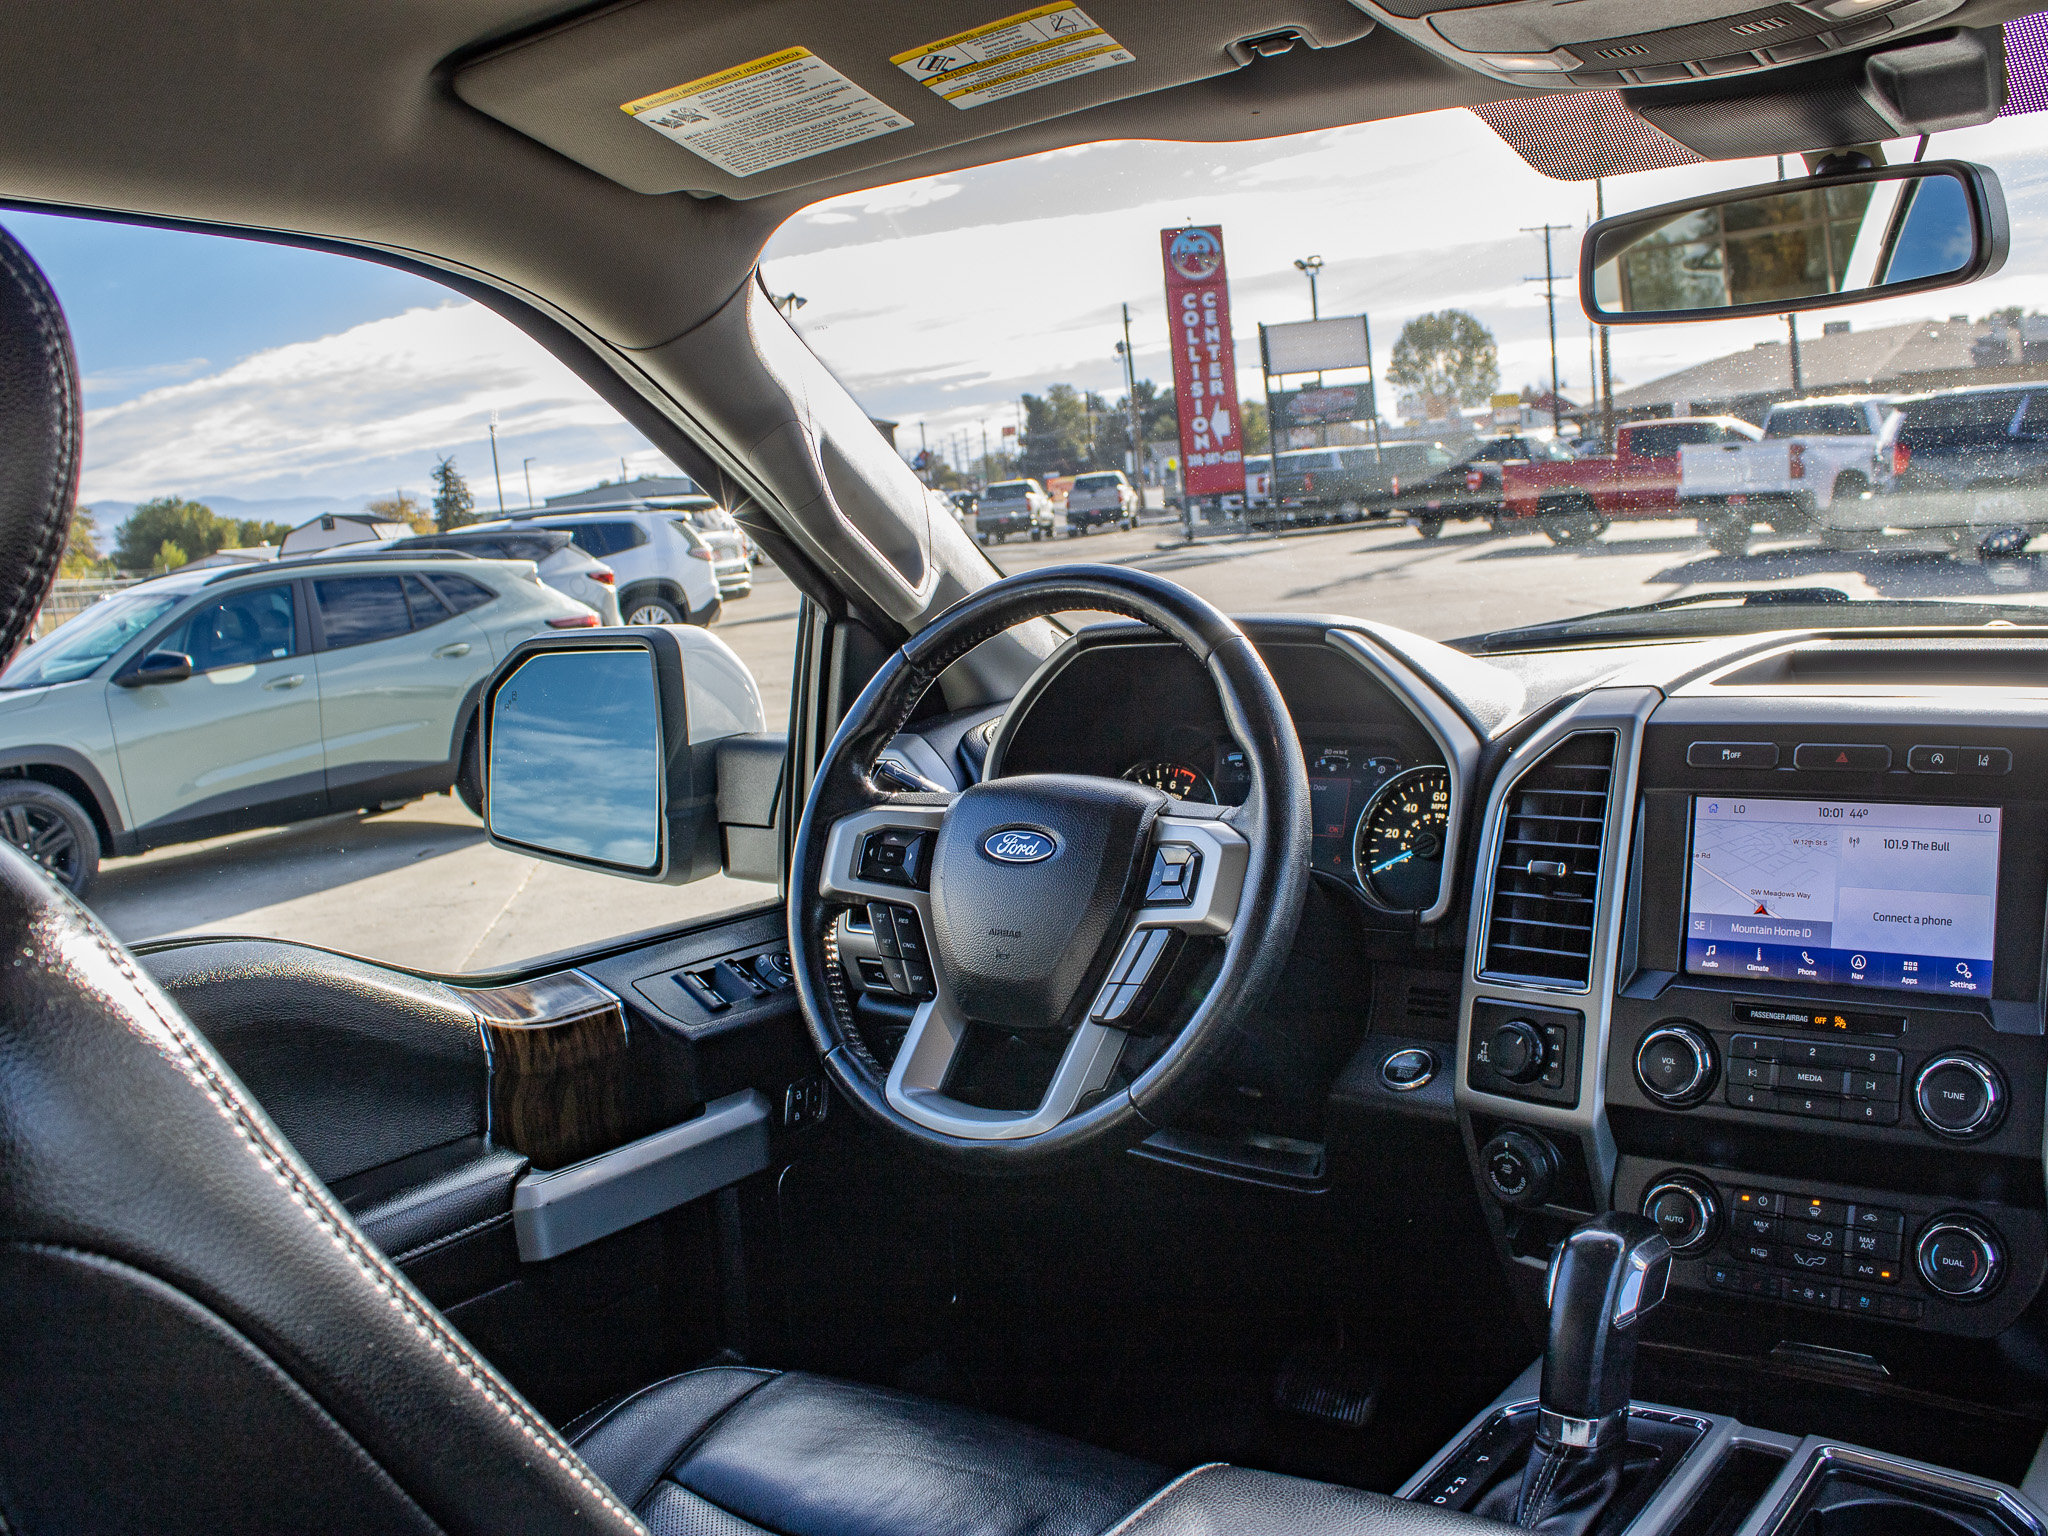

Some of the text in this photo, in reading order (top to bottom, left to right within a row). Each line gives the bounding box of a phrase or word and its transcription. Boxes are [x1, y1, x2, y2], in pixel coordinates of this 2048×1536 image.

[1202, 292, 1225, 396] CENTER
[1182, 292, 1211, 450] COLLISION
[1730, 751, 1742, 759] OFF
[1156, 781, 1162, 790] 5
[1169, 780, 1177, 790] 6
[1183, 785, 1191, 796] 7
[1432, 791, 1448, 802] 60
[1403, 803, 1418, 813] 40
[1733, 804, 1746, 814] LO
[1818, 807, 1844, 818] 10:01
[1978, 814, 1992, 824] LO
[1384, 828, 1400, 839] 20
[996, 834, 1040, 857] Ford
[1800, 839, 1814, 847] 12th
[1883, 838, 1950, 852] 101.9 The Bull
[1750, 888, 1811, 899] SW Meadows Way
[1872, 911, 1953, 927] Connect a phone
[1694, 920, 1706, 931] SE
[1731, 923, 1812, 938] Mountain Home ID
[1701, 960, 1719, 968] Audio
[1746, 963, 1770, 973] Climate
[1797, 968, 1817, 976] Phone
[1851, 972, 1865, 980] Nav
[1901, 976, 1918, 985] Apps
[1949, 980, 1977, 990] Settings
[1750, 1011, 1827, 1025] PASSENGER AIRBAG OFF
[1809, 1048, 1816, 1056] 2
[1661, 1057, 1676, 1065] VOL
[1869, 1053, 1876, 1062] 3
[1797, 1073, 1823, 1083] MEDIA
[1747, 1095, 1754, 1103] 4
[1942, 1090, 1965, 1101] TUNE
[1805, 1101, 1812, 1109] 5
[1866, 1107, 1872, 1116] 6
[1664, 1214, 1684, 1224] AUTO
[1753, 1219, 1770, 1229] MAX
[1858, 1236, 1876, 1245] MAX
[1750, 1247, 1757, 1255] R
[1859, 1242, 1874, 1250] A/C
[1942, 1257, 1965, 1268] DUAL
[1858, 1265, 1874, 1274] A/C
[1454, 1476, 1467, 1485] R
[1444, 1485, 1459, 1494] N
[1433, 1495, 1447, 1504] D
